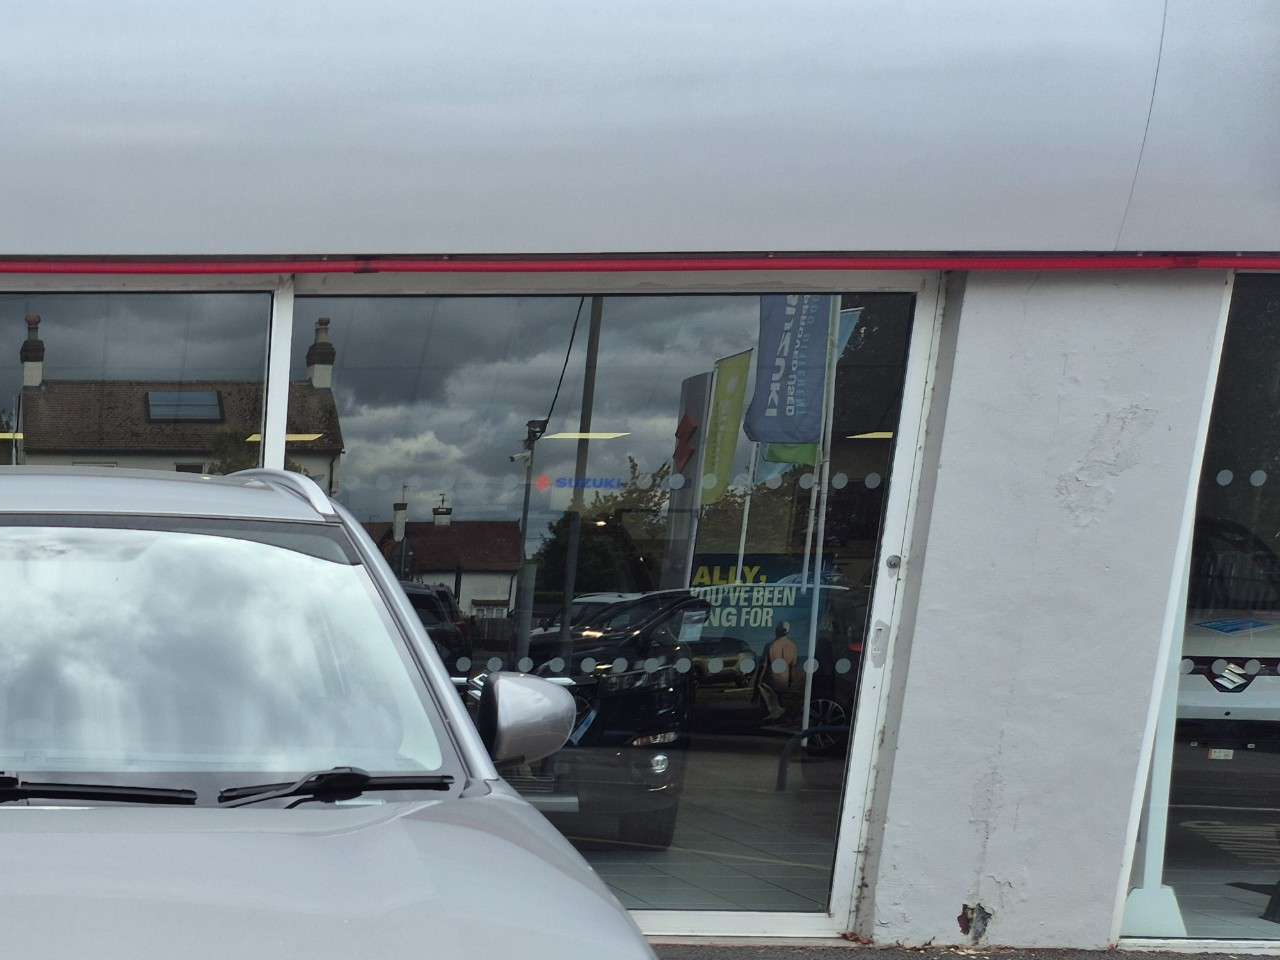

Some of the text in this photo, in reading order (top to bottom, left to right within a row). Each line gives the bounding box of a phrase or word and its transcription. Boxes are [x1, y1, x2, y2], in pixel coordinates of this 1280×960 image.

[555, 477, 625, 489] SUZUKI
[692, 565, 768, 586] ALLY,
[752, 586, 797, 607] BEEN
[703, 607, 737, 628] NG
[740, 607, 774, 628] FOR
